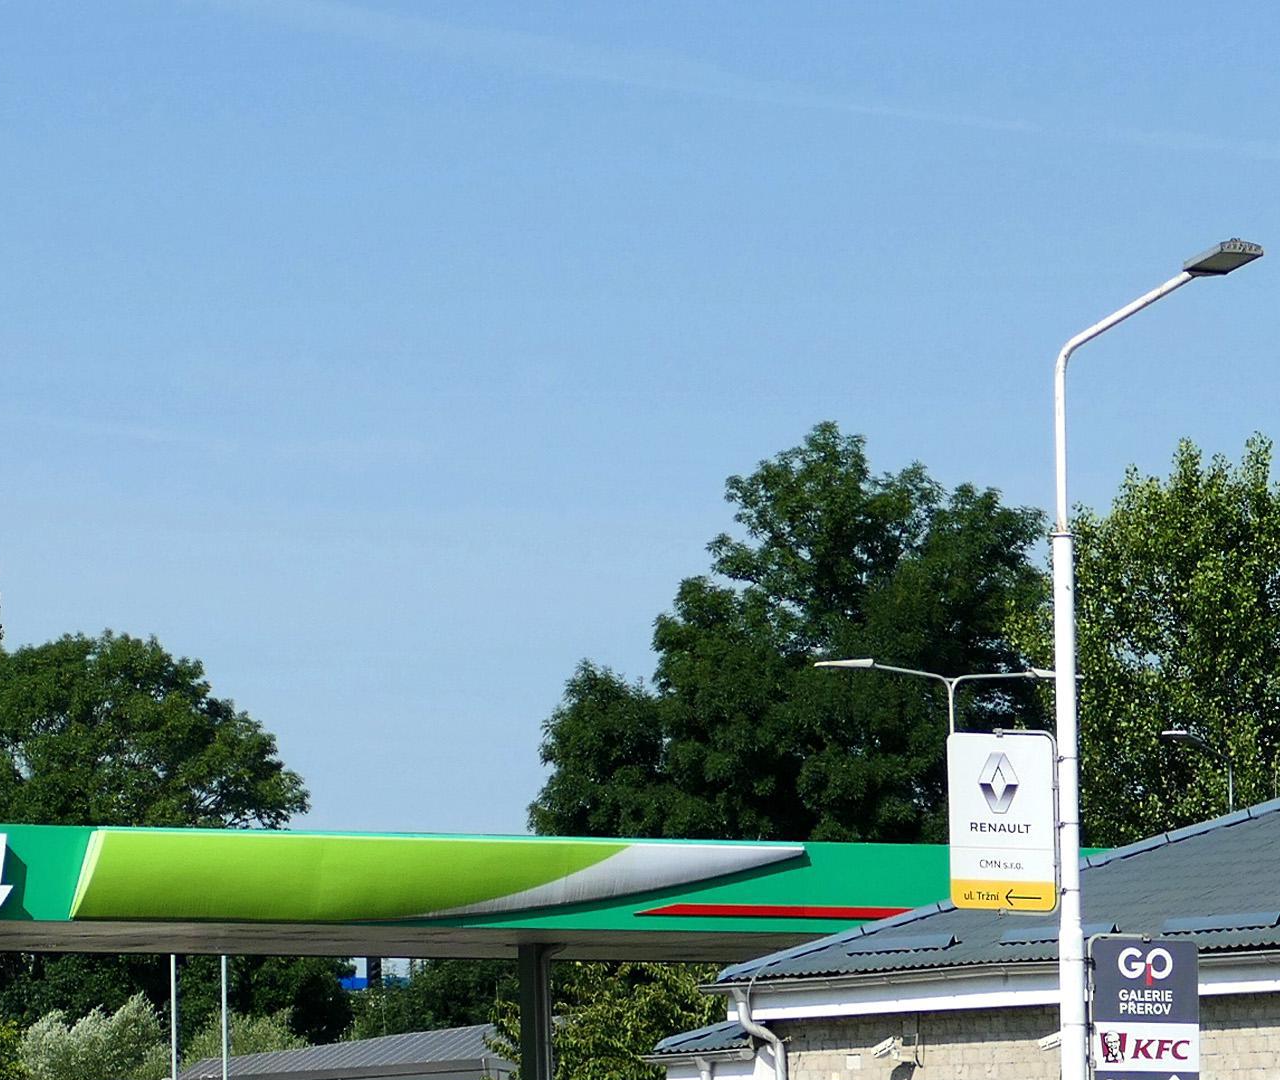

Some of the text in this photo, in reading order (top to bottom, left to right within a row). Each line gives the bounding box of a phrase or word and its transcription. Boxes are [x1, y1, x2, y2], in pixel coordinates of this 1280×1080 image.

[970, 821, 1031, 834] RENAULT
[979, 859, 1024, 870] CMN s.r.o.
[963, 890, 1000, 901] ul. Tržní
[1118, 989, 1173, 1002] GALERIE
[1119, 1001, 1172, 1016] PŘEROV
[1131, 1039, 1191, 1061] KFC
